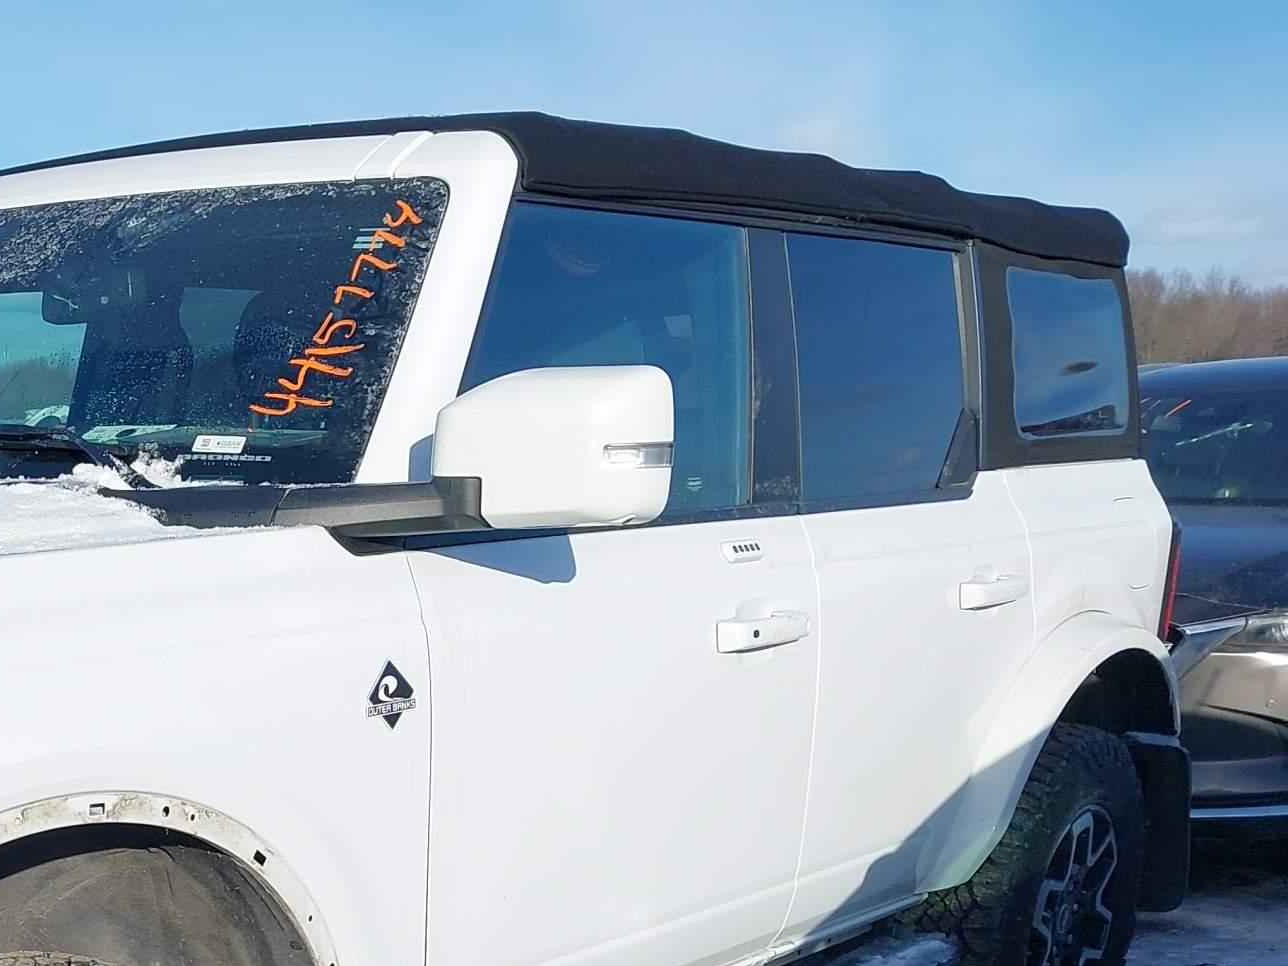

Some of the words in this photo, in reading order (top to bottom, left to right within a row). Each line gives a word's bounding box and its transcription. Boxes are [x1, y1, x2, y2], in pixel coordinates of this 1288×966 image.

[248, 199, 424, 416] 44157774
[368, 703, 392, 716] OUTER
[392, 699, 416, 712] BANKS
